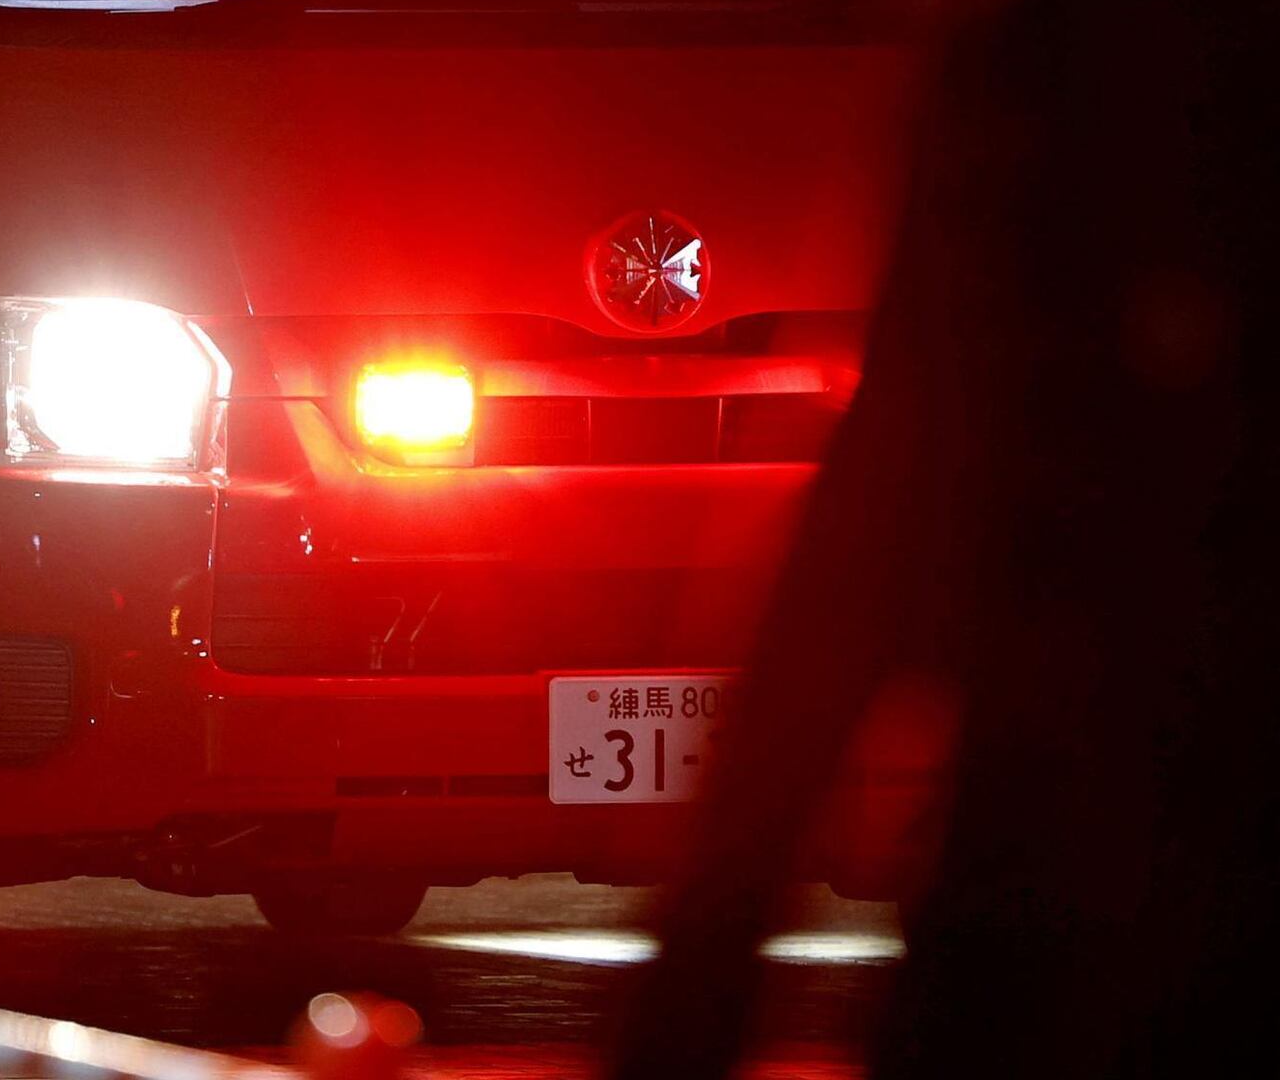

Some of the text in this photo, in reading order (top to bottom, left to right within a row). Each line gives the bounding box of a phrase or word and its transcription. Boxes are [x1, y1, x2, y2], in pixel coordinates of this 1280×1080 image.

[609, 686, 723, 719] 練馬 80
[563, 746, 594, 778] せ
